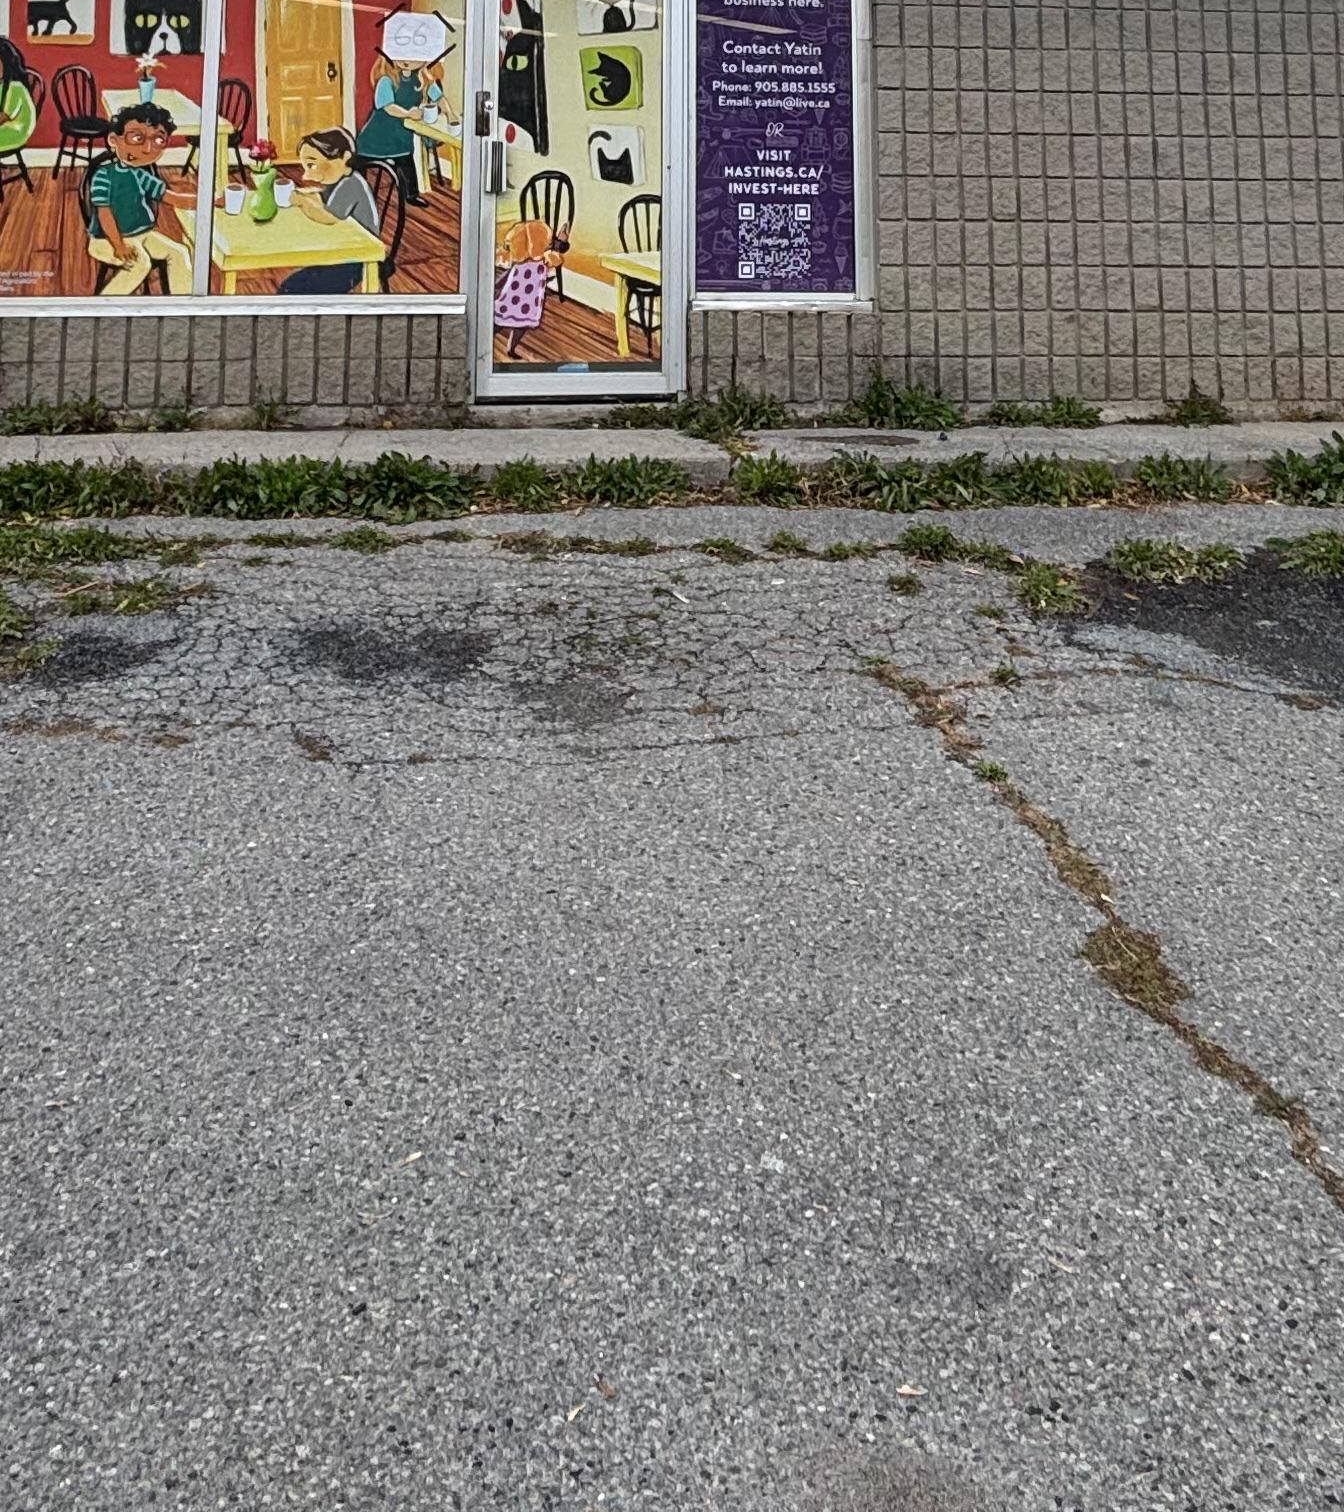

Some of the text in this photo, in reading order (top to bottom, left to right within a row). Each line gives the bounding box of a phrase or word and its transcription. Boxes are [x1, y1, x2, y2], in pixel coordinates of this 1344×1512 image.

[394, 22, 428, 47] 66
[722, 40, 822, 56] Contact Yatin
[721, 59, 824, 75] to learn more!
[712, 80, 836, 94] Phone: 905.885.1555
[718, 95, 831, 110] Email: yatin@live.ca
[765, 122, 785, 138] OR
[756, 150, 792, 161] VISIT
[724, 165, 824, 181] HASTINGS.CA/
[728, 182, 820, 195] INVEST-HERE
